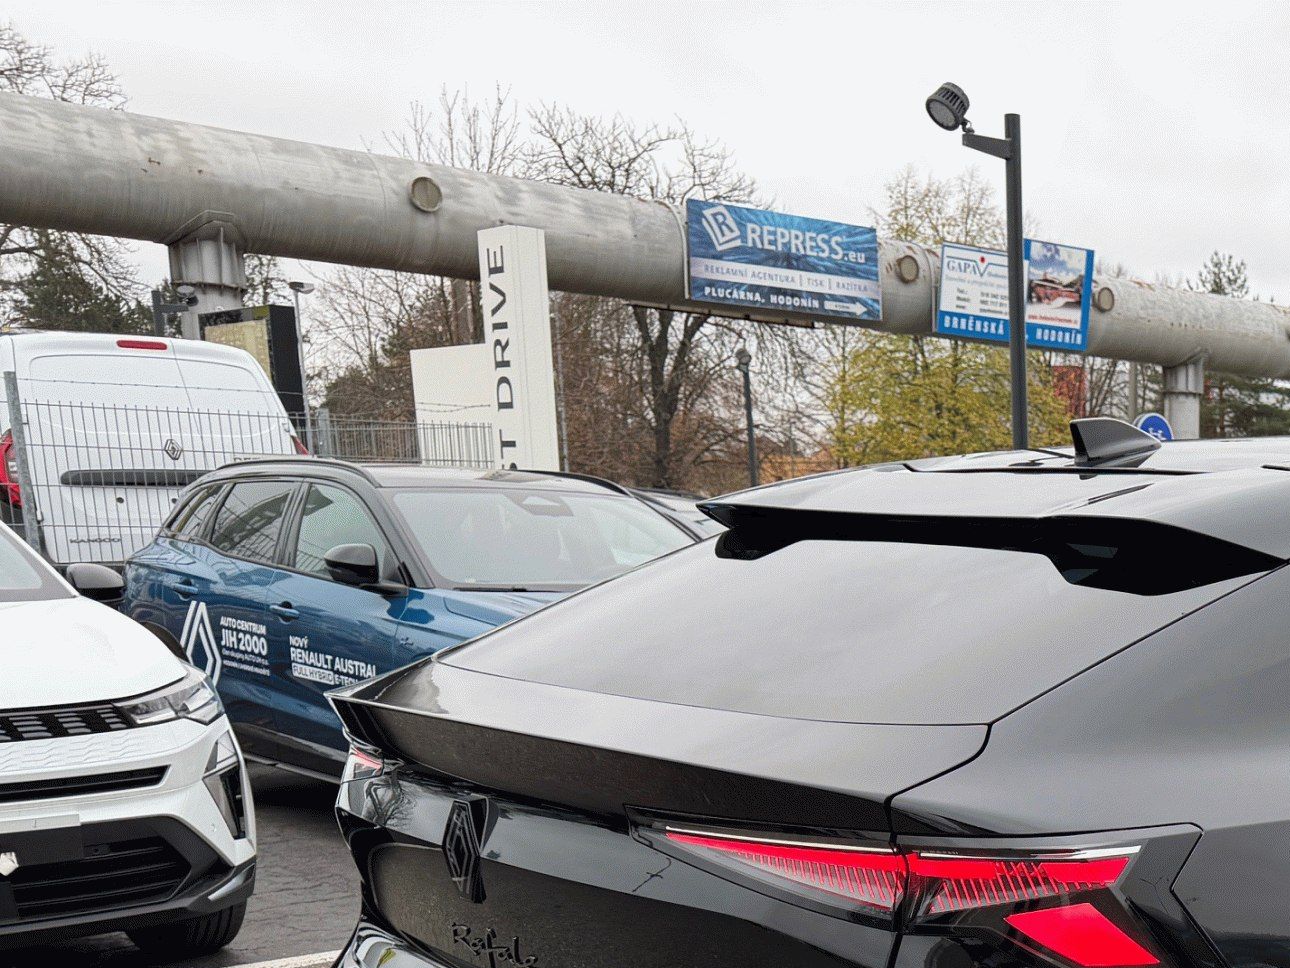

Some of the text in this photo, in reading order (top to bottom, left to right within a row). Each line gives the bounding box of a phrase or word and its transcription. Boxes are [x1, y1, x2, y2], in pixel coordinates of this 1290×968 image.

[746, 222, 866, 264] REPRESS.eu
[750, 271, 795, 284] AGENTURA
[770, 294, 820, 309] HODONÍN
[486, 244, 515, 412] DRIVE
[220, 616, 267, 636] AUTO CENTRUM
[220, 627, 268, 656] JIH 2000
[289, 635, 309, 649] NOVÝ
[290, 647, 333, 670] RENAULT
